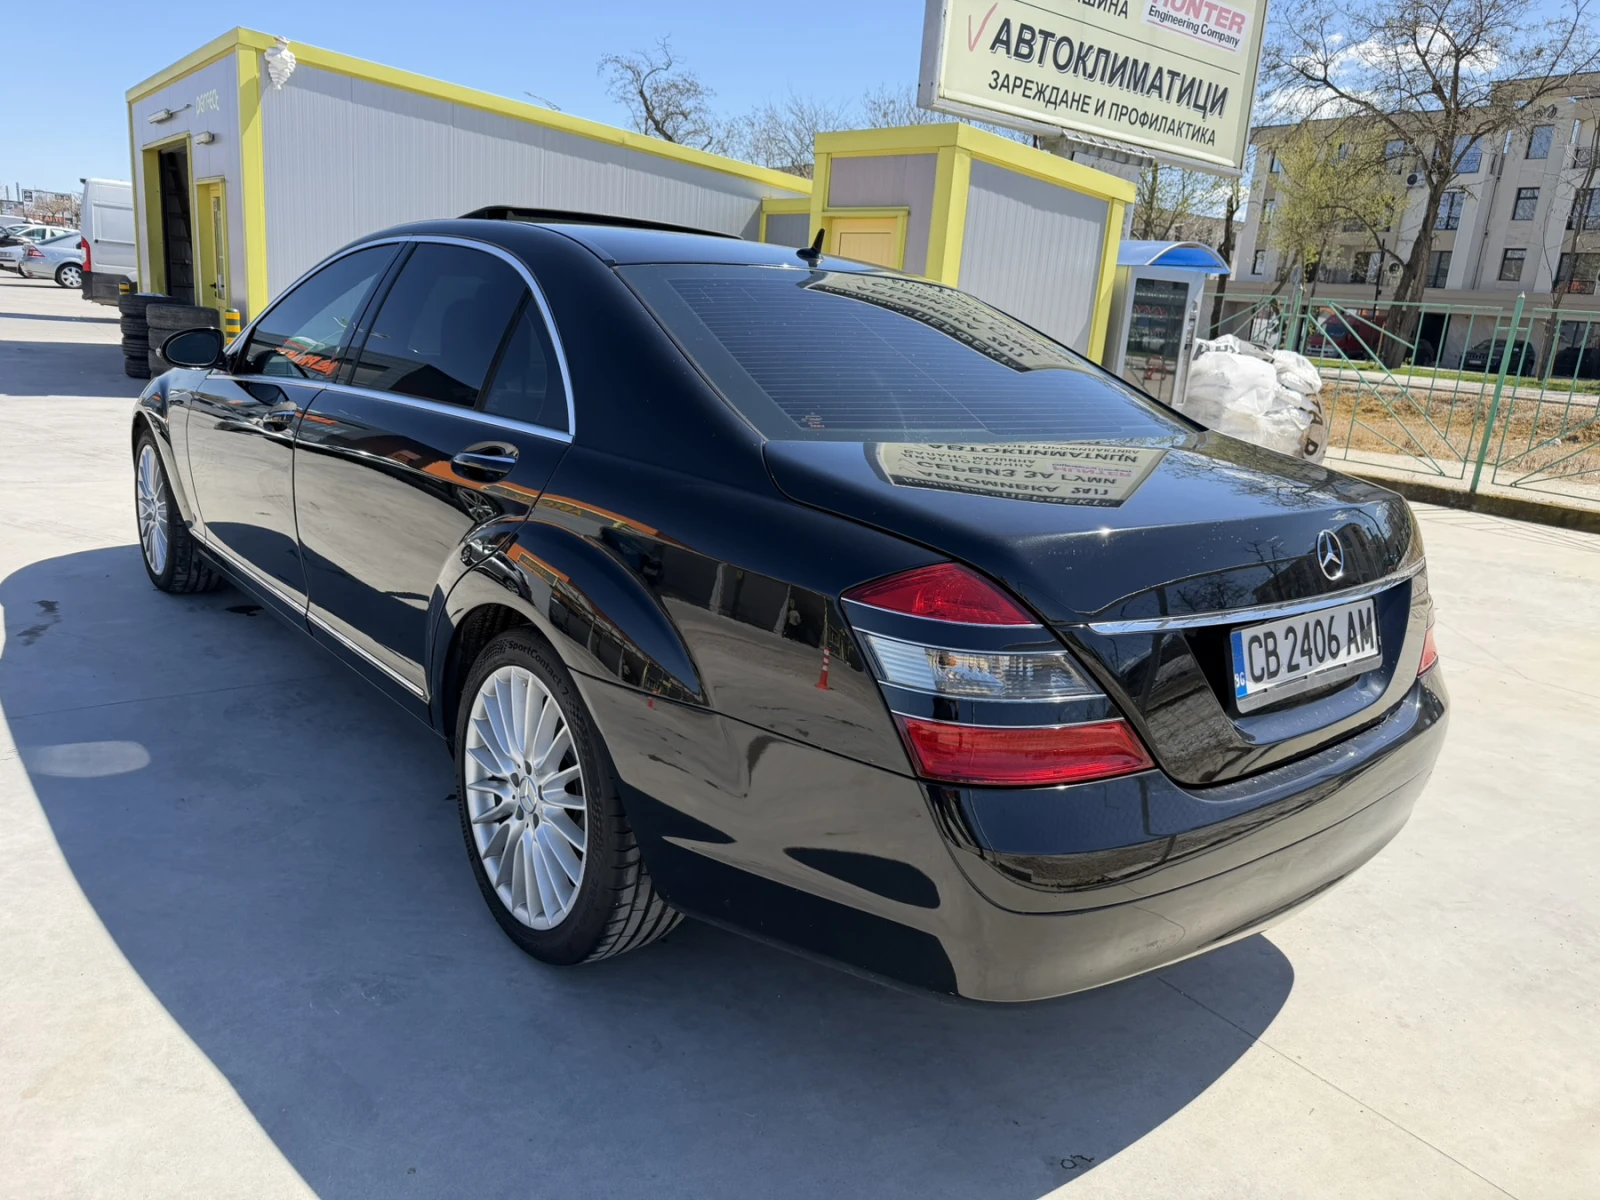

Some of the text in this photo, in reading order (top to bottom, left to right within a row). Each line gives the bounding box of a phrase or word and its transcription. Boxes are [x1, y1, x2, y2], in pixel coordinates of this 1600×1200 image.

[1148, 5, 1240, 48] Engineering Company
[990, 17, 1229, 121] АВТОКЛИМАТИЦИ
[988, 69, 1216, 147] ЗАРЕЖДАНЕ И ПРОФИЛАКТИКА
[508, 640, 563, 688] SportContact
[1284, 615, 1340, 673] 2406
